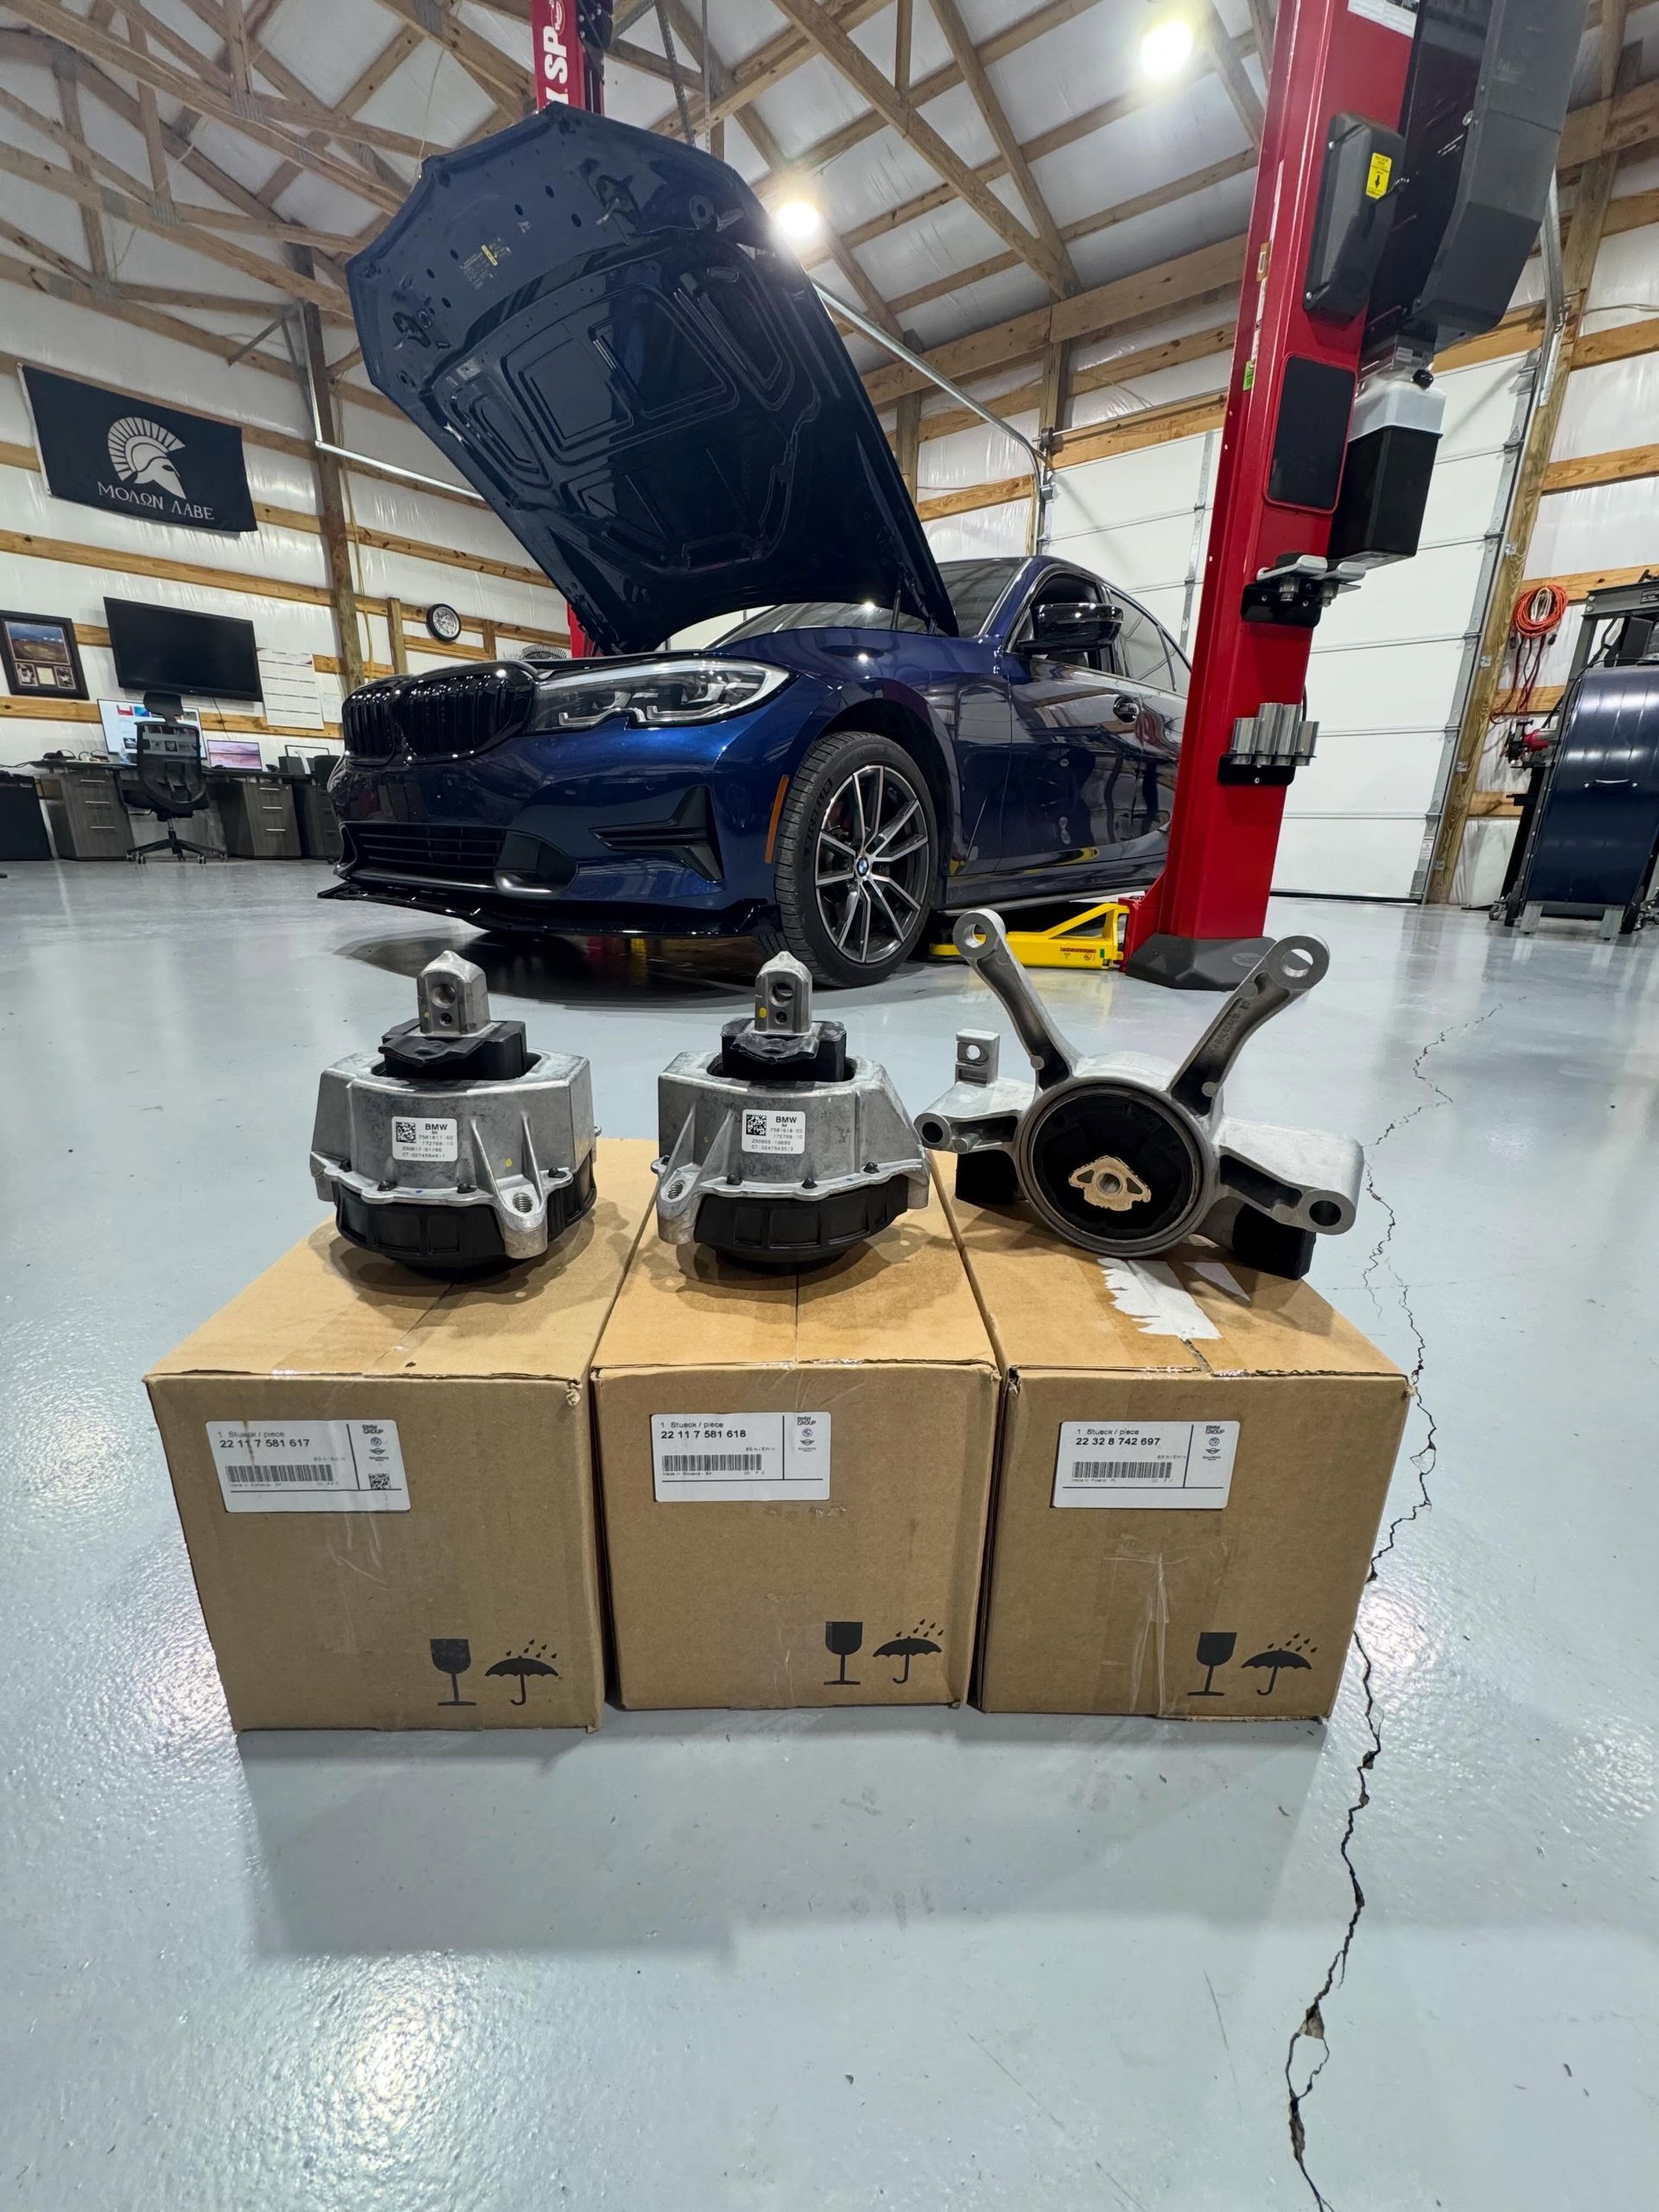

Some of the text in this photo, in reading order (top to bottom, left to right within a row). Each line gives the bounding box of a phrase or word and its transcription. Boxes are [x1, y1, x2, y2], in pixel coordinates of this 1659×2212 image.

[219, 1440, 234, 1448] 22
[238, 1440, 250, 1448] 11
[289, 1439, 310, 1447] 617
